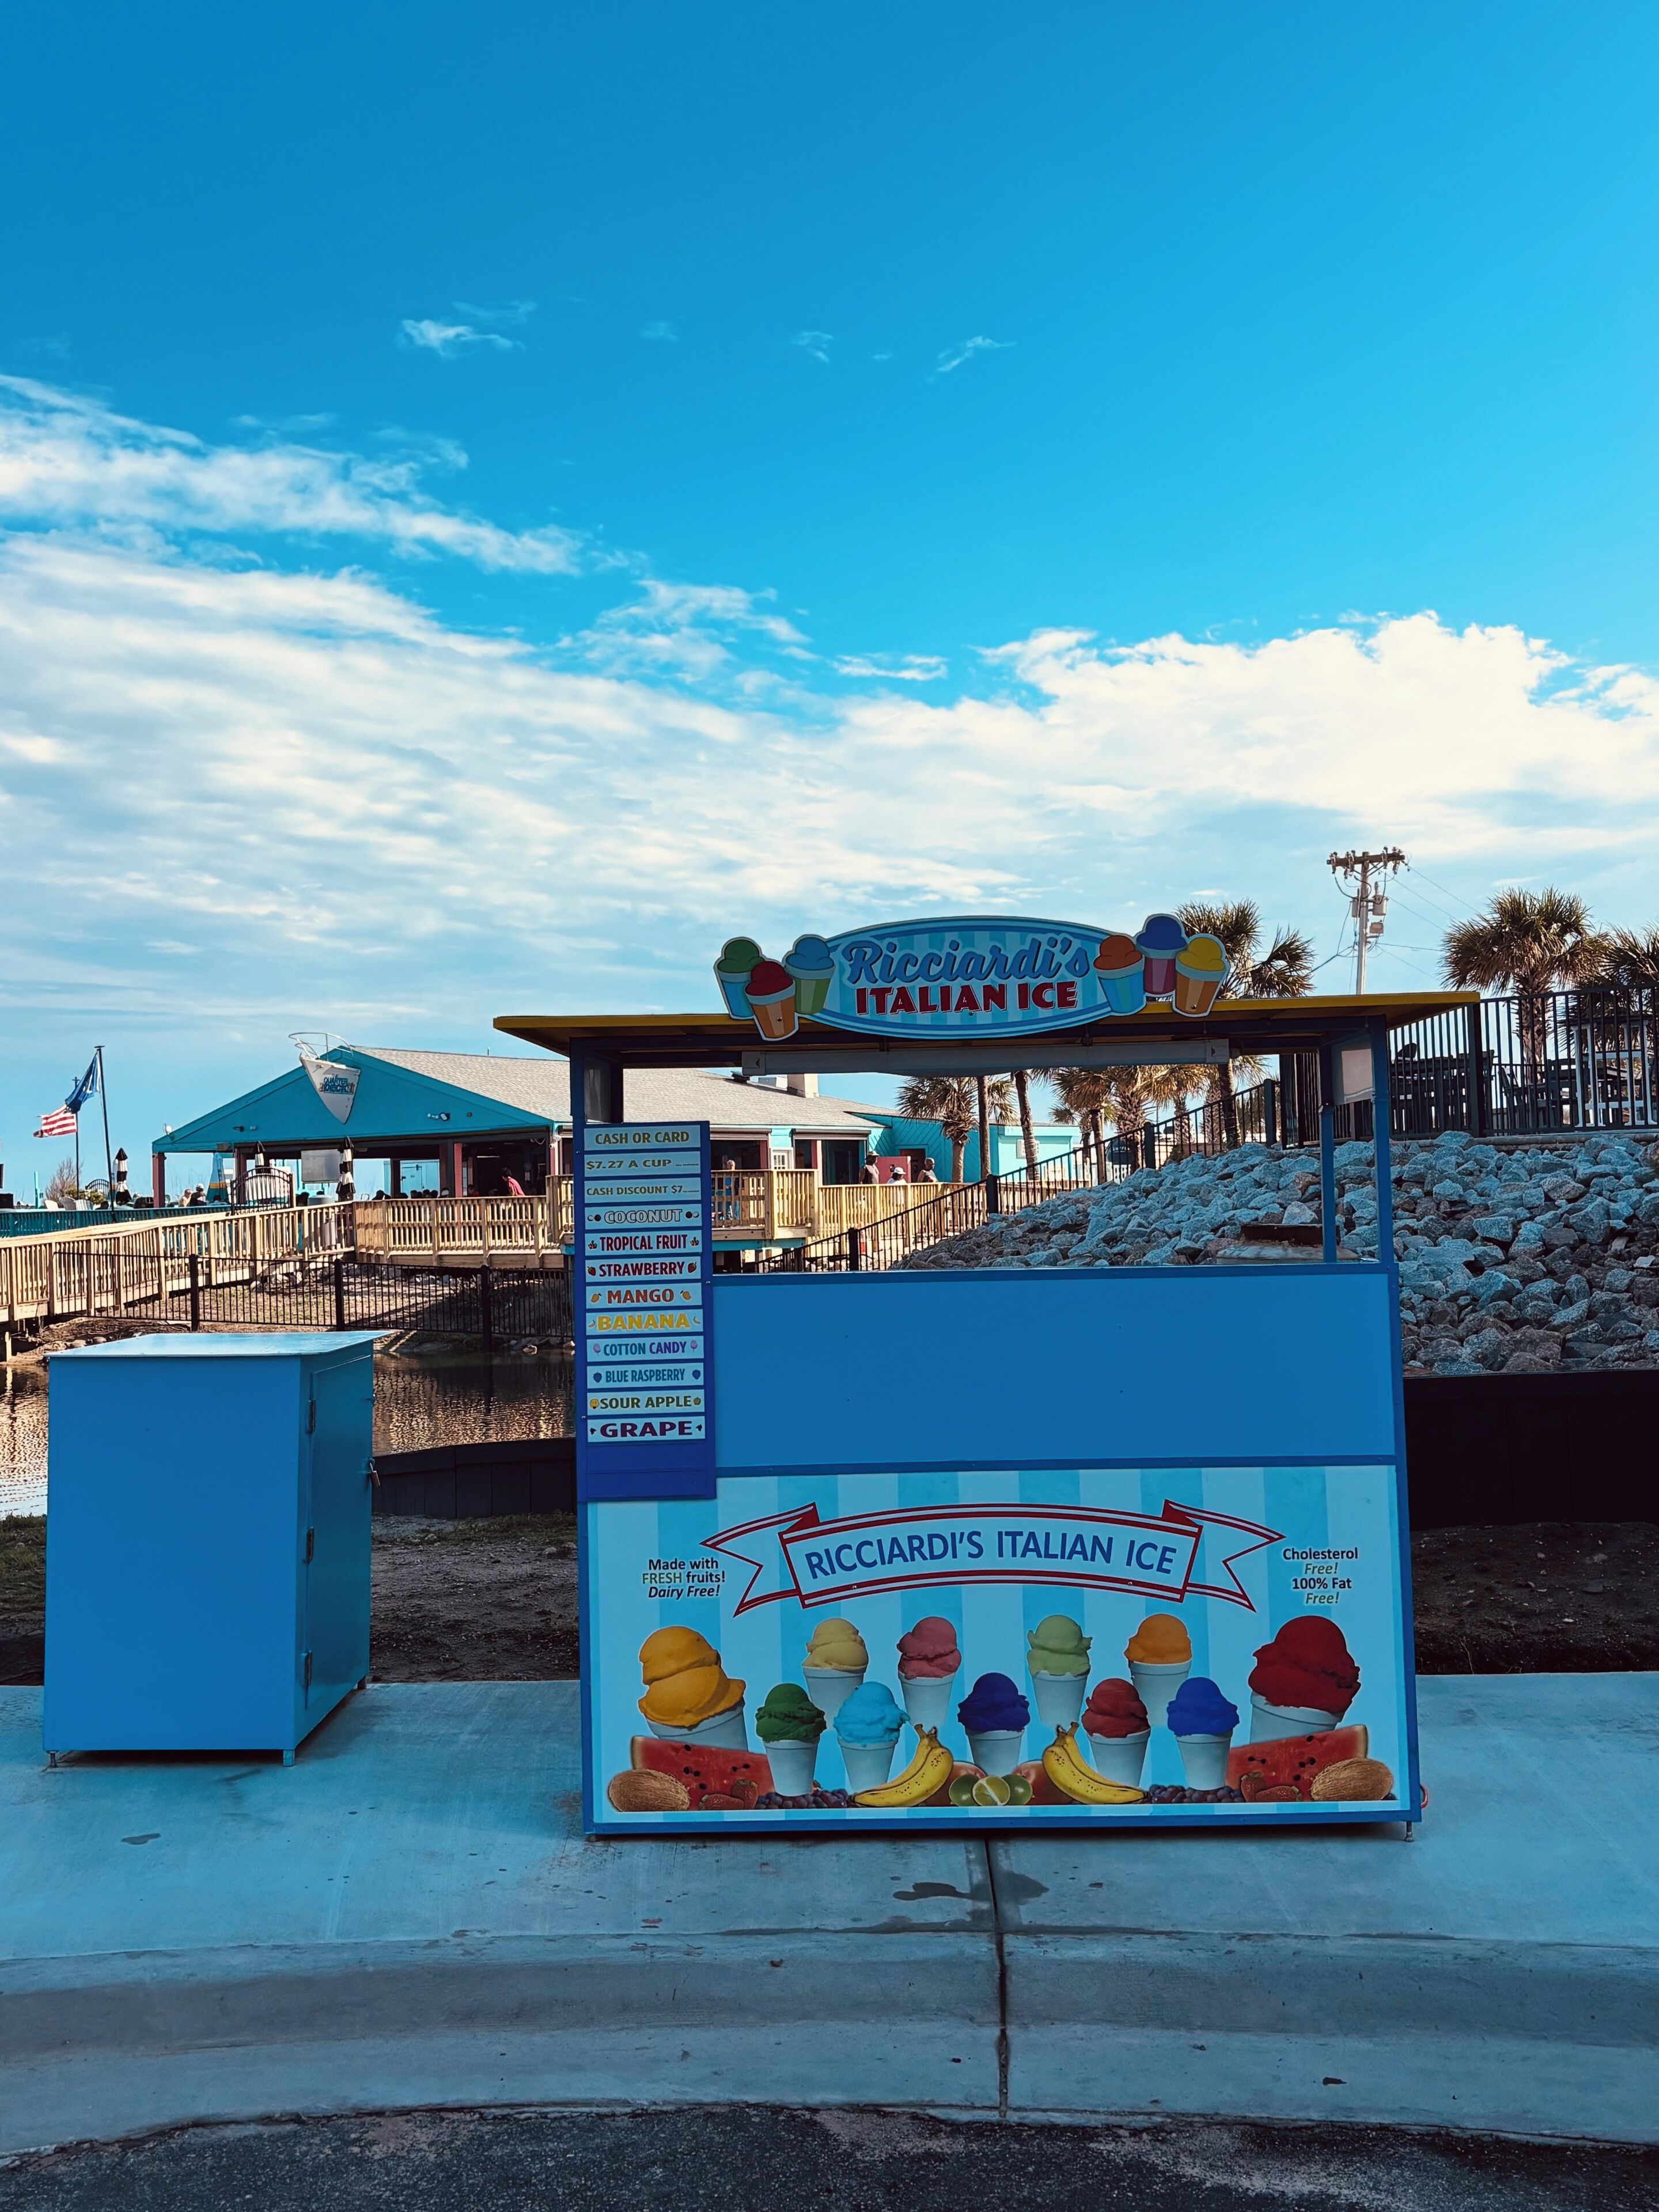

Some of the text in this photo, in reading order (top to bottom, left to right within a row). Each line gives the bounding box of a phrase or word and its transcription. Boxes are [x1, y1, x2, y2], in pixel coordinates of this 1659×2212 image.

[842, 936, 1090, 984] Ricciardi's
[856, 981, 1077, 1015] ITALIAN ICE
[595, 1131, 690, 1145] CASH OR CARD
[586, 1159, 672, 1170] $7.27 A CUP
[616, 1185, 668, 1195] DISCOUNT
[671, 1185, 683, 1194] $7
[604, 1209, 683, 1224] COCONUT
[600, 1234, 688, 1251] TROPICAL FRUIT
[599, 1261, 685, 1277] STRAWBERRY
[607, 1289, 675, 1304] MANGO
[597, 1313, 691, 1331] BANANA
[604, 1341, 687, 1356] COTTON CANDY
[605, 1368, 685, 1383] BLUE RASPBERRY
[600, 1396, 691, 1410] SOUR APPLE
[600, 1421, 692, 1438] GRAPE
[805, 1530, 1177, 1580] RICCIARDI'S ITALIAN ICE
[1283, 1547, 1358, 1560] Cholesterol
[649, 1557, 718, 1570] Made with
[1305, 1562, 1338, 1574] Free!
[642, 1570, 725, 1584] FRESH fruits!
[1292, 1577, 1352, 1589] 100% Fat
[648, 1584, 720, 1600] Dairy Free!
[1306, 1592, 1339, 1604] Free!
